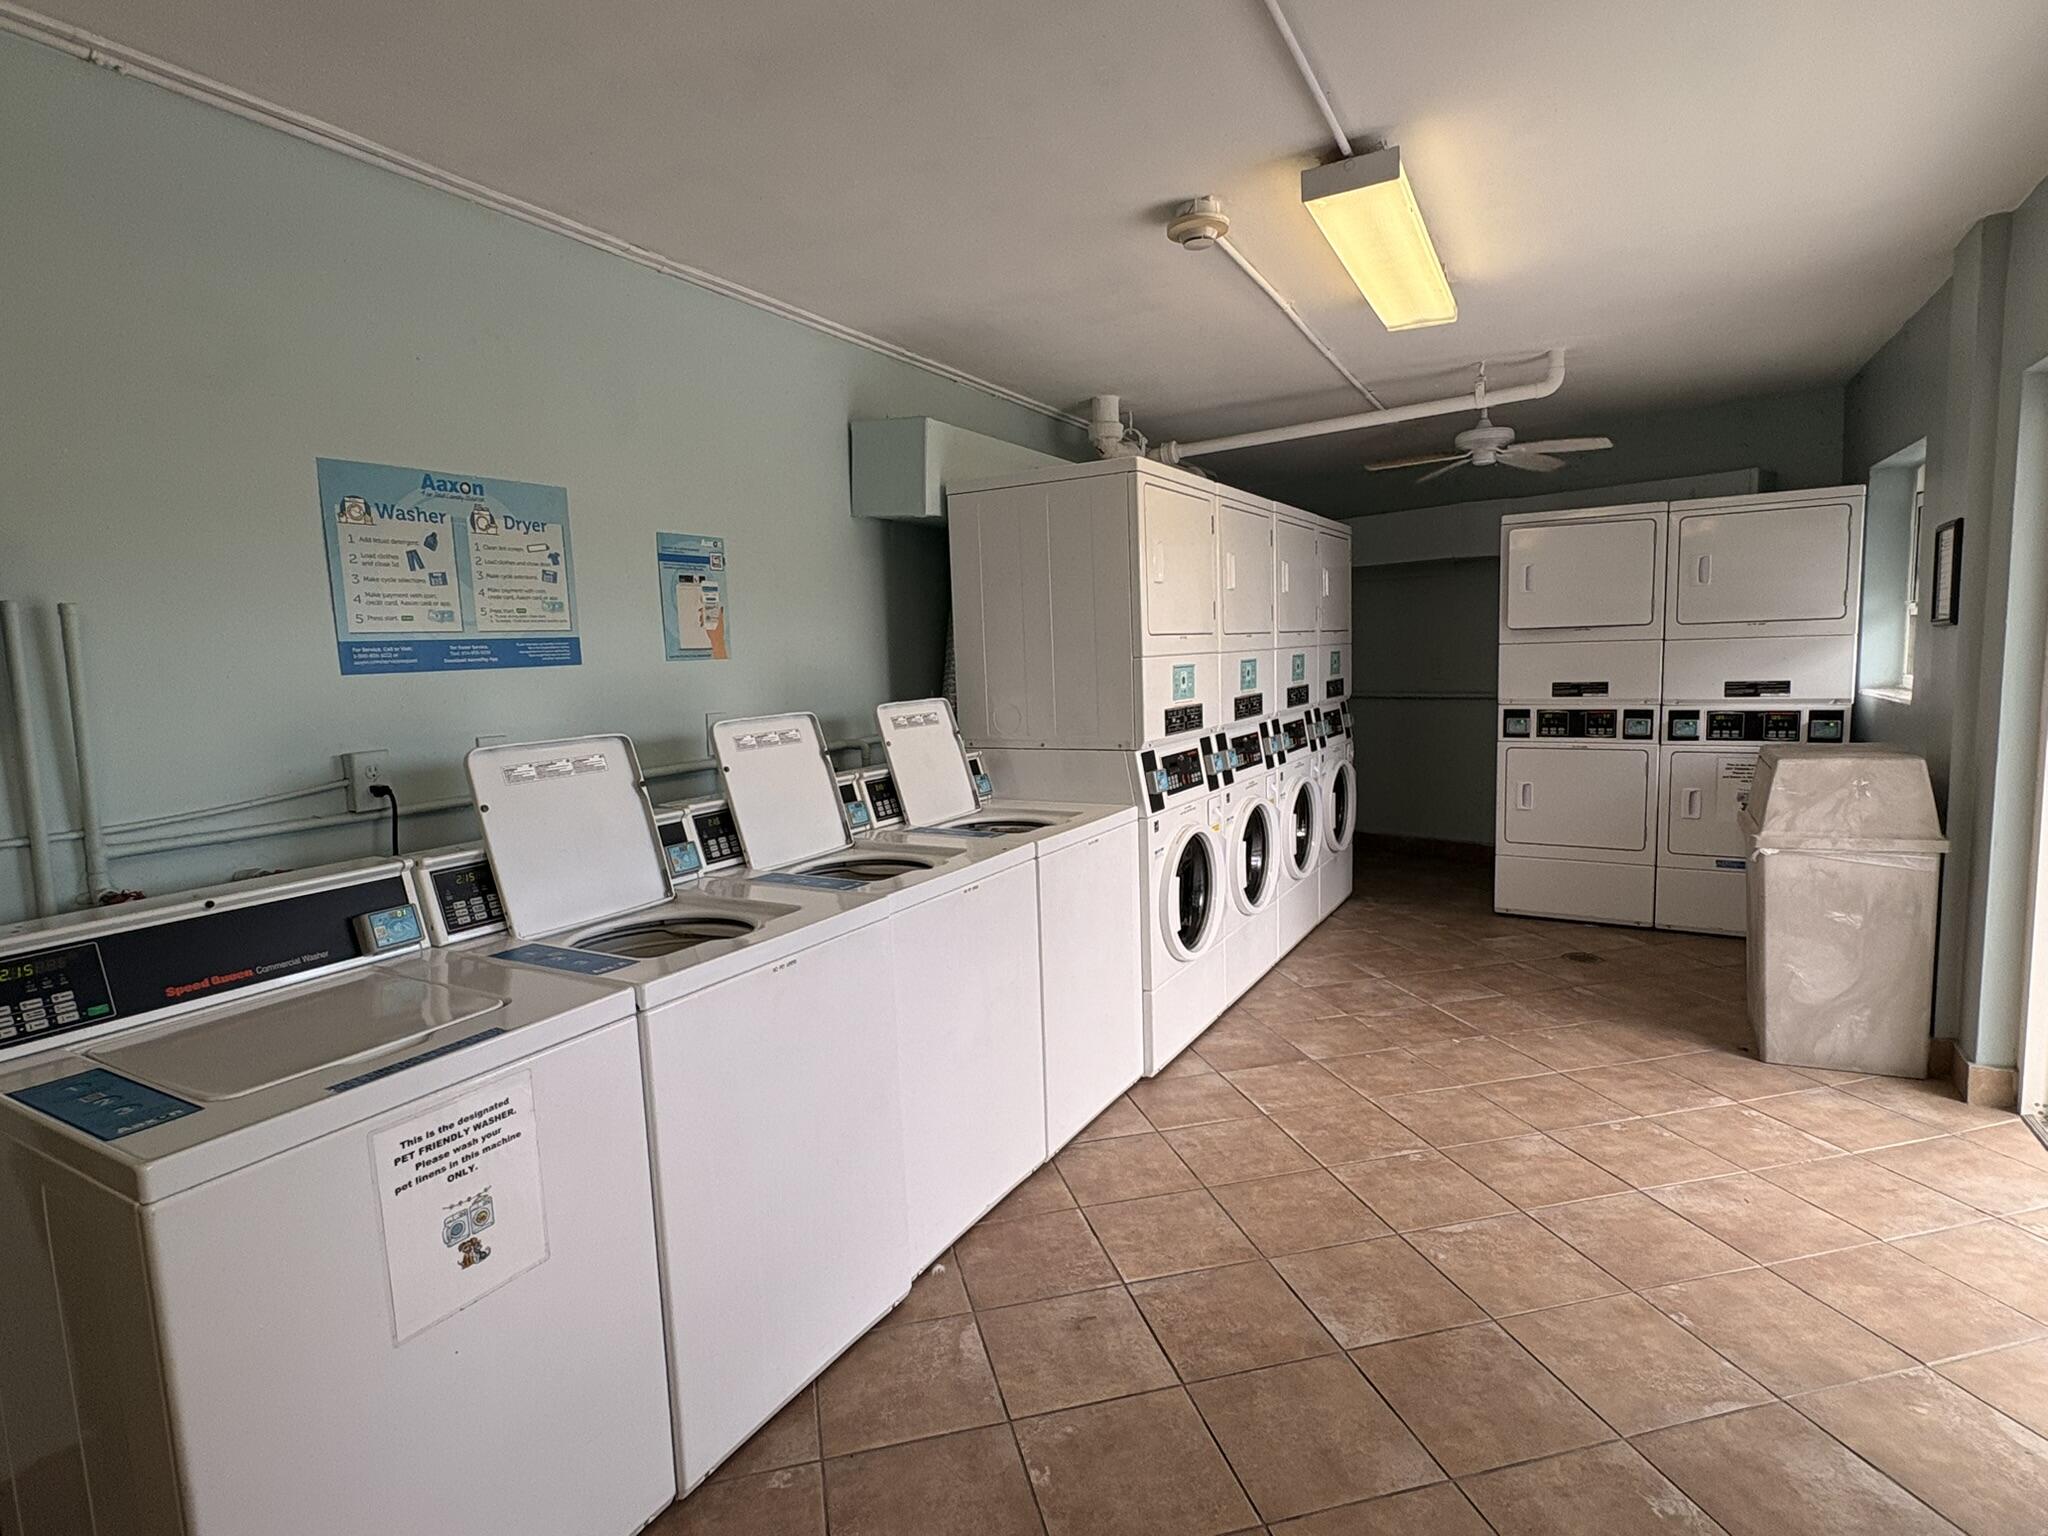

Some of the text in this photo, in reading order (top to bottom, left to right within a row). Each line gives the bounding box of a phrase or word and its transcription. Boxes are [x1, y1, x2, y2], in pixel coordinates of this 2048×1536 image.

[421, 473, 485, 496] Aaxon
[374, 502, 448, 525] Washer
[503, 515, 548, 535] Dryer
[348, 534, 356, 544] 1
[474, 542, 480, 552] 1
[349, 554, 358, 564] 2
[475, 556, 482, 566] 2
[351, 574, 360, 584] 3
[476, 570, 484, 580] 3
[478, 588, 485, 597] 4
[353, 594, 362, 604] 4
[480, 607, 488, 616] 5
[355, 614, 364, 624] 5
[165, 950, 329, 997] Speed Queen Commercial Washer
[399, 1098, 510, 1150] This is the designated
[394, 1108, 517, 1166] PET FRIENDLY WASHER.
[415, 1126, 503, 1171] Please wash your
[394, 1130, 522, 1196] pet linens in this machine
[447, 1165, 479, 1183] ONLY.
